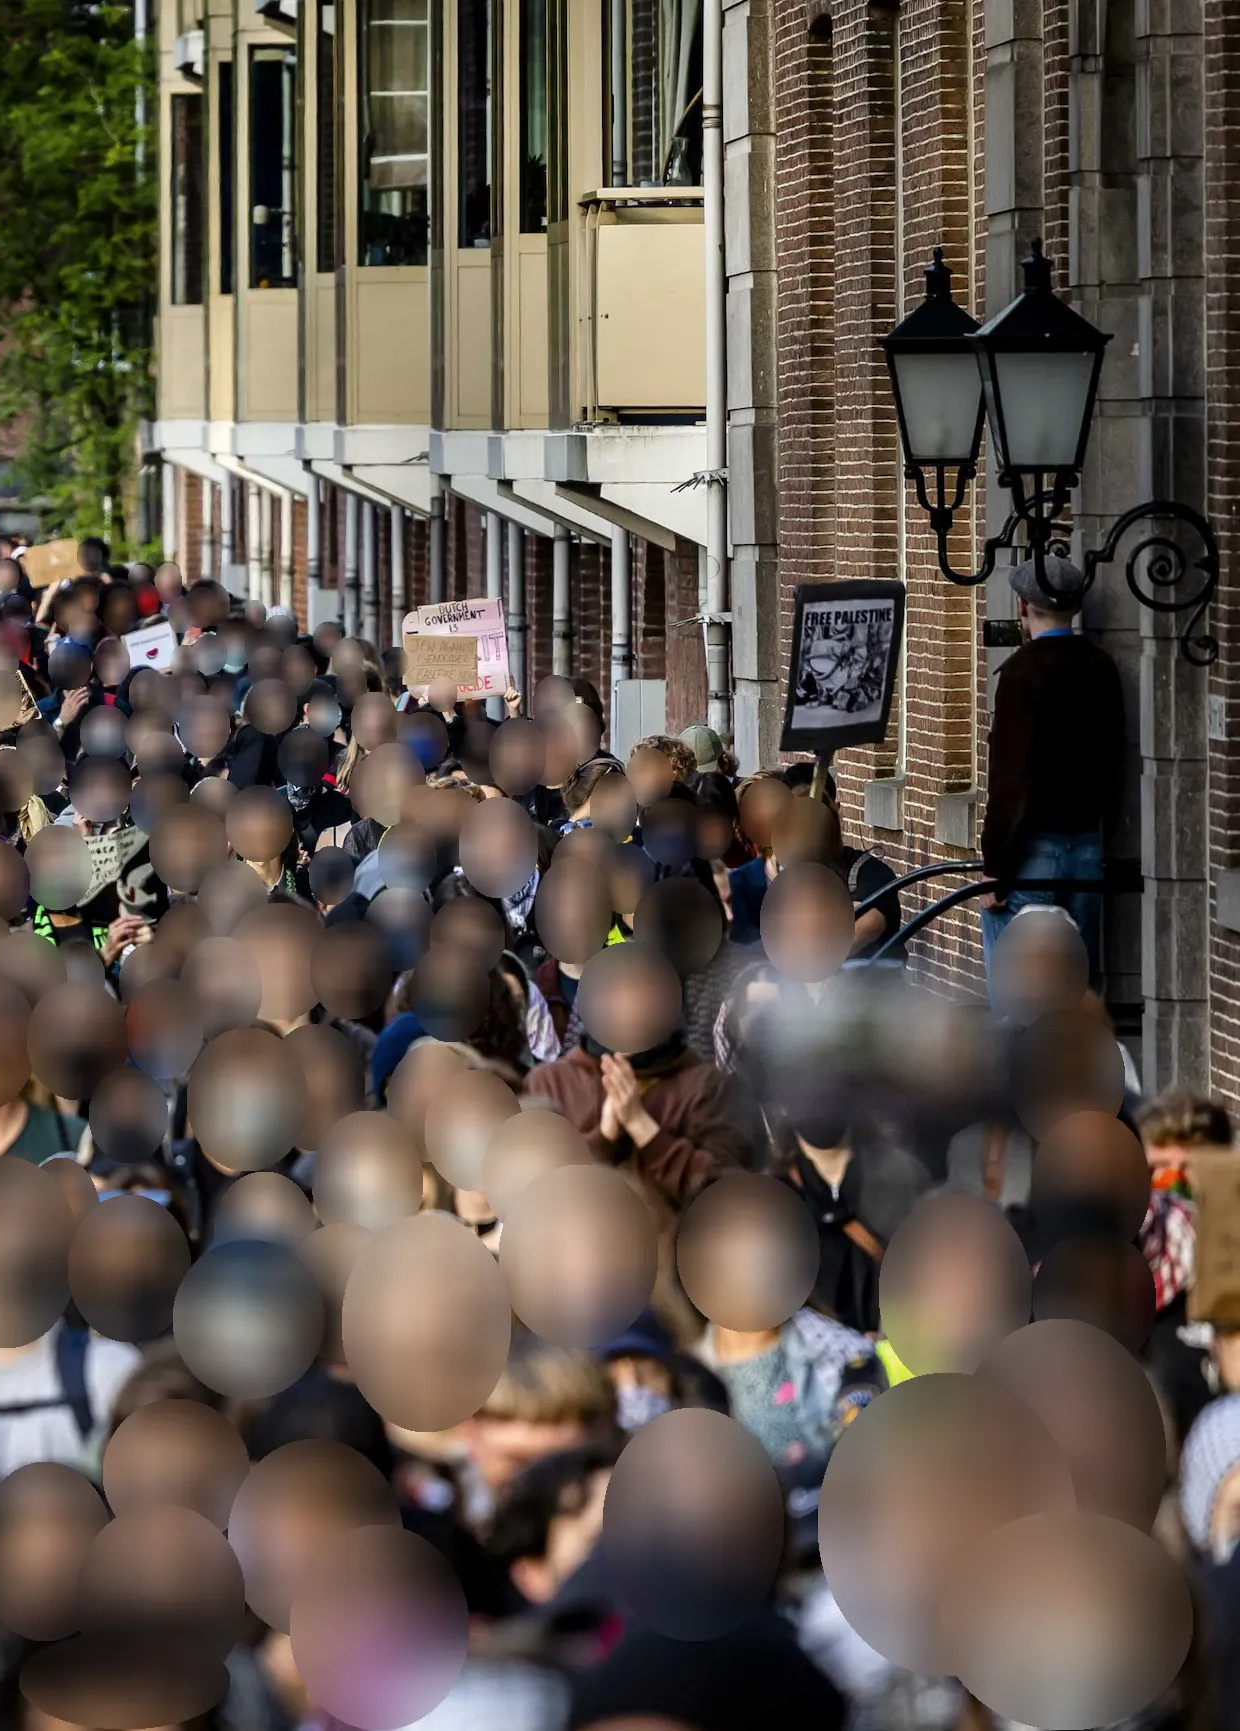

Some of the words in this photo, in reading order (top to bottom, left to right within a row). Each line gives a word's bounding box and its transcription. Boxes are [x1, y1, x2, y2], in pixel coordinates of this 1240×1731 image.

[439, 602, 469, 614] DUTCH
[424, 609, 486, 626] GOVERNMENT
[805, 611, 832, 625] FREE
[834, 607, 892, 625] PALESTINE
[449, 624, 459, 633] IS
